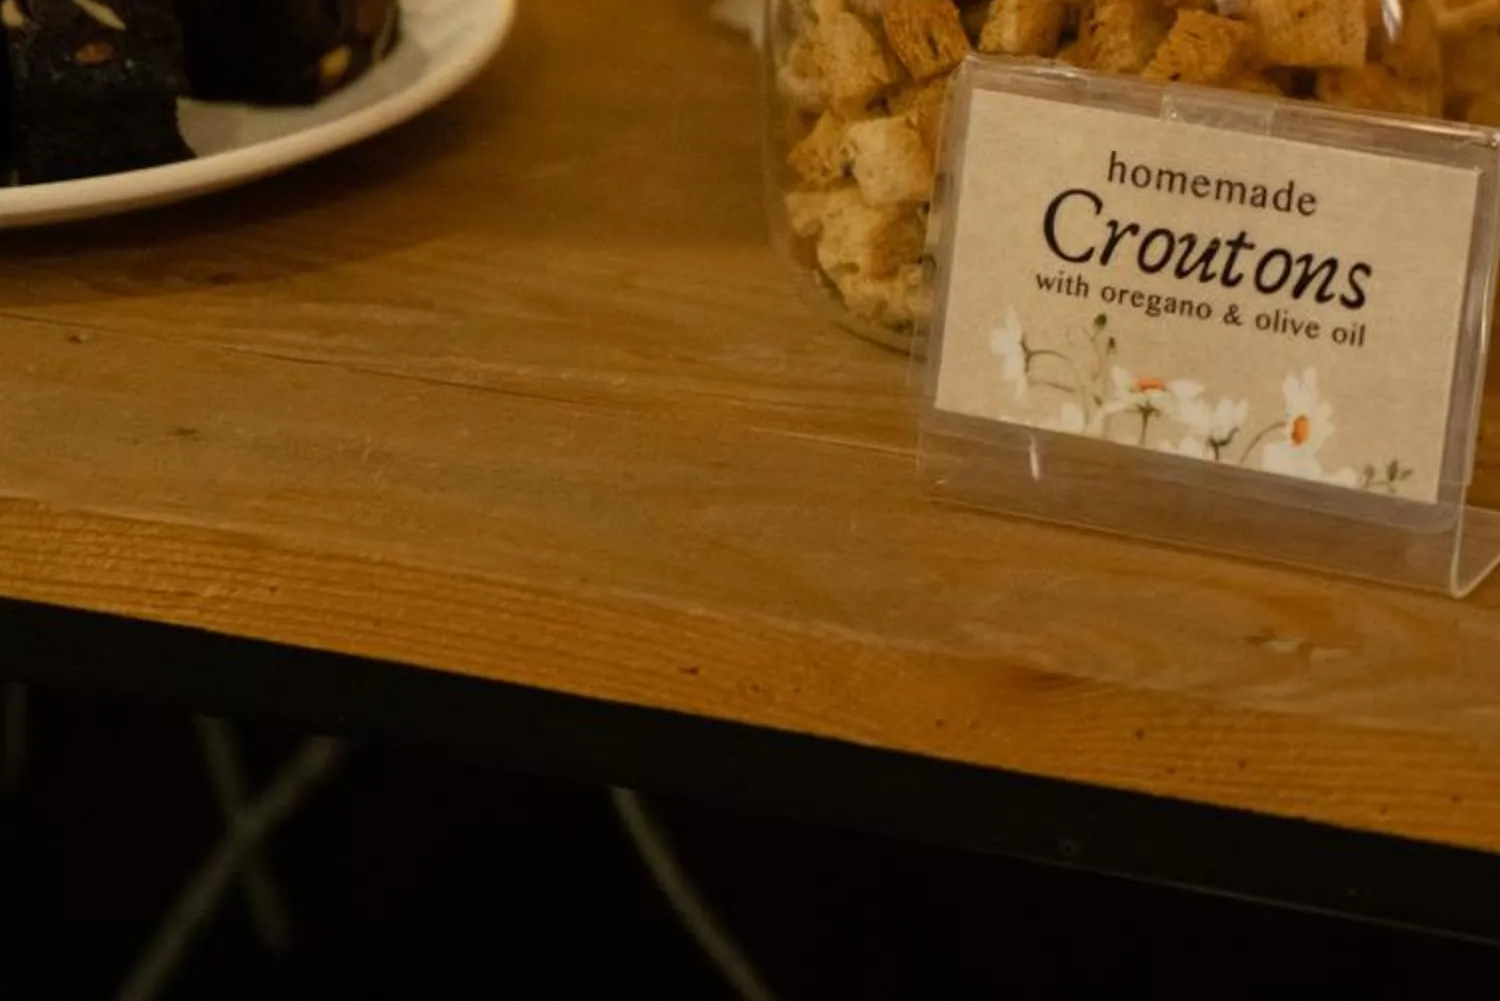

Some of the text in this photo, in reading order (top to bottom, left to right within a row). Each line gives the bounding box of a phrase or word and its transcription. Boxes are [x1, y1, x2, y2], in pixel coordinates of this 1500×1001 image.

[1107, 150, 1318, 216] homemade
[1043, 188, 1373, 309] Croutons
[1036, 270, 1366, 347] with oregano & olive oil
